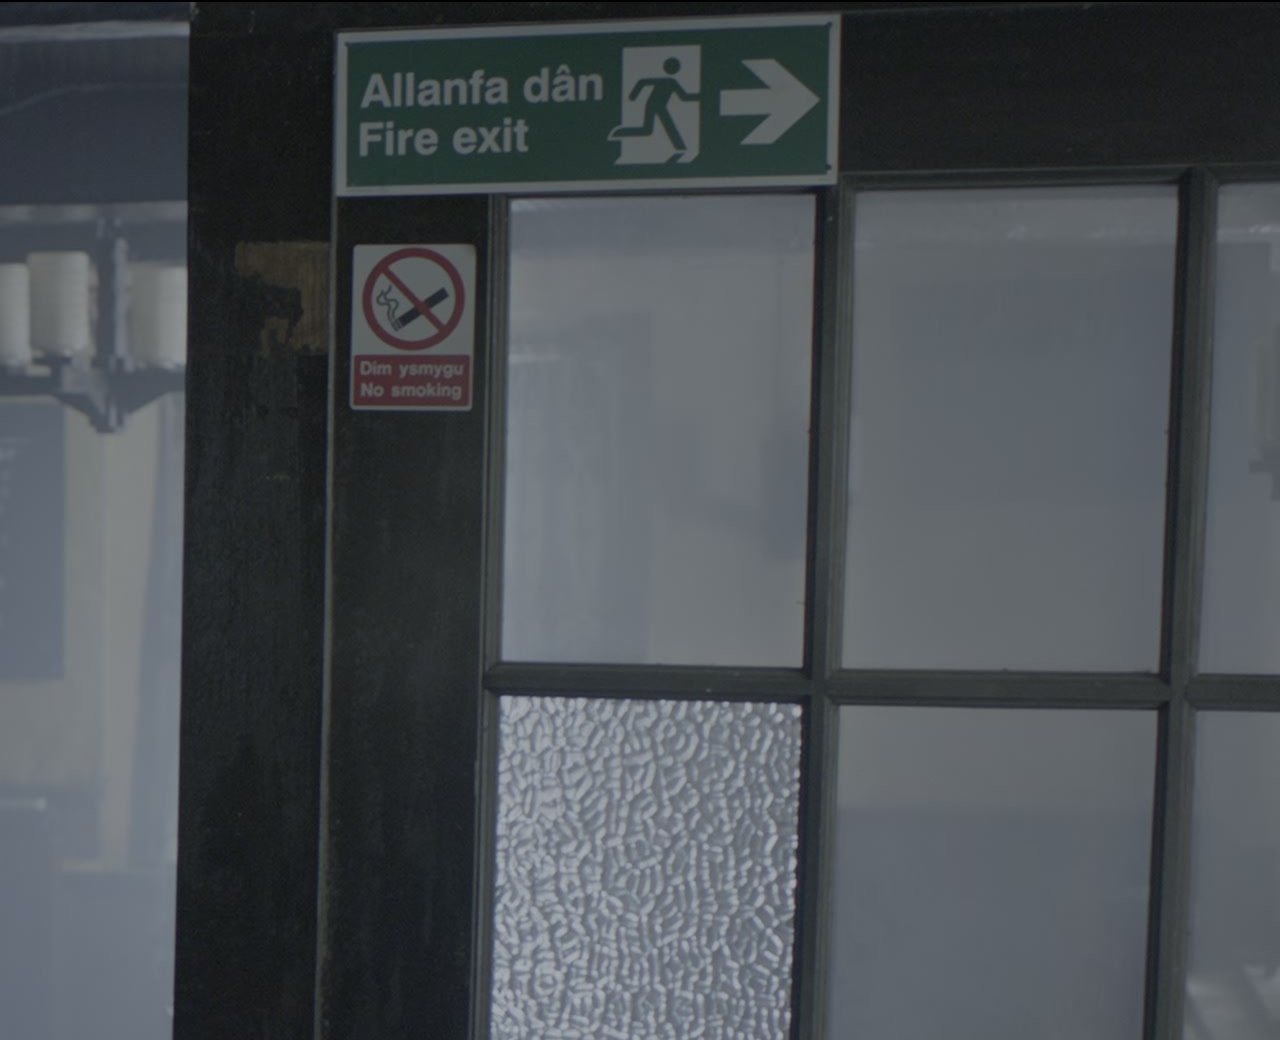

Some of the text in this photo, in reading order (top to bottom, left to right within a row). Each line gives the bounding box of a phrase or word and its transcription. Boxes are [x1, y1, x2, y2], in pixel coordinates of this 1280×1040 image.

[360, 64, 603, 108] Allanfa dân
[359, 117, 529, 157] Fire exit
[360, 361, 464, 378] Dim ysmygu
[360, 382, 461, 401] No smoking
